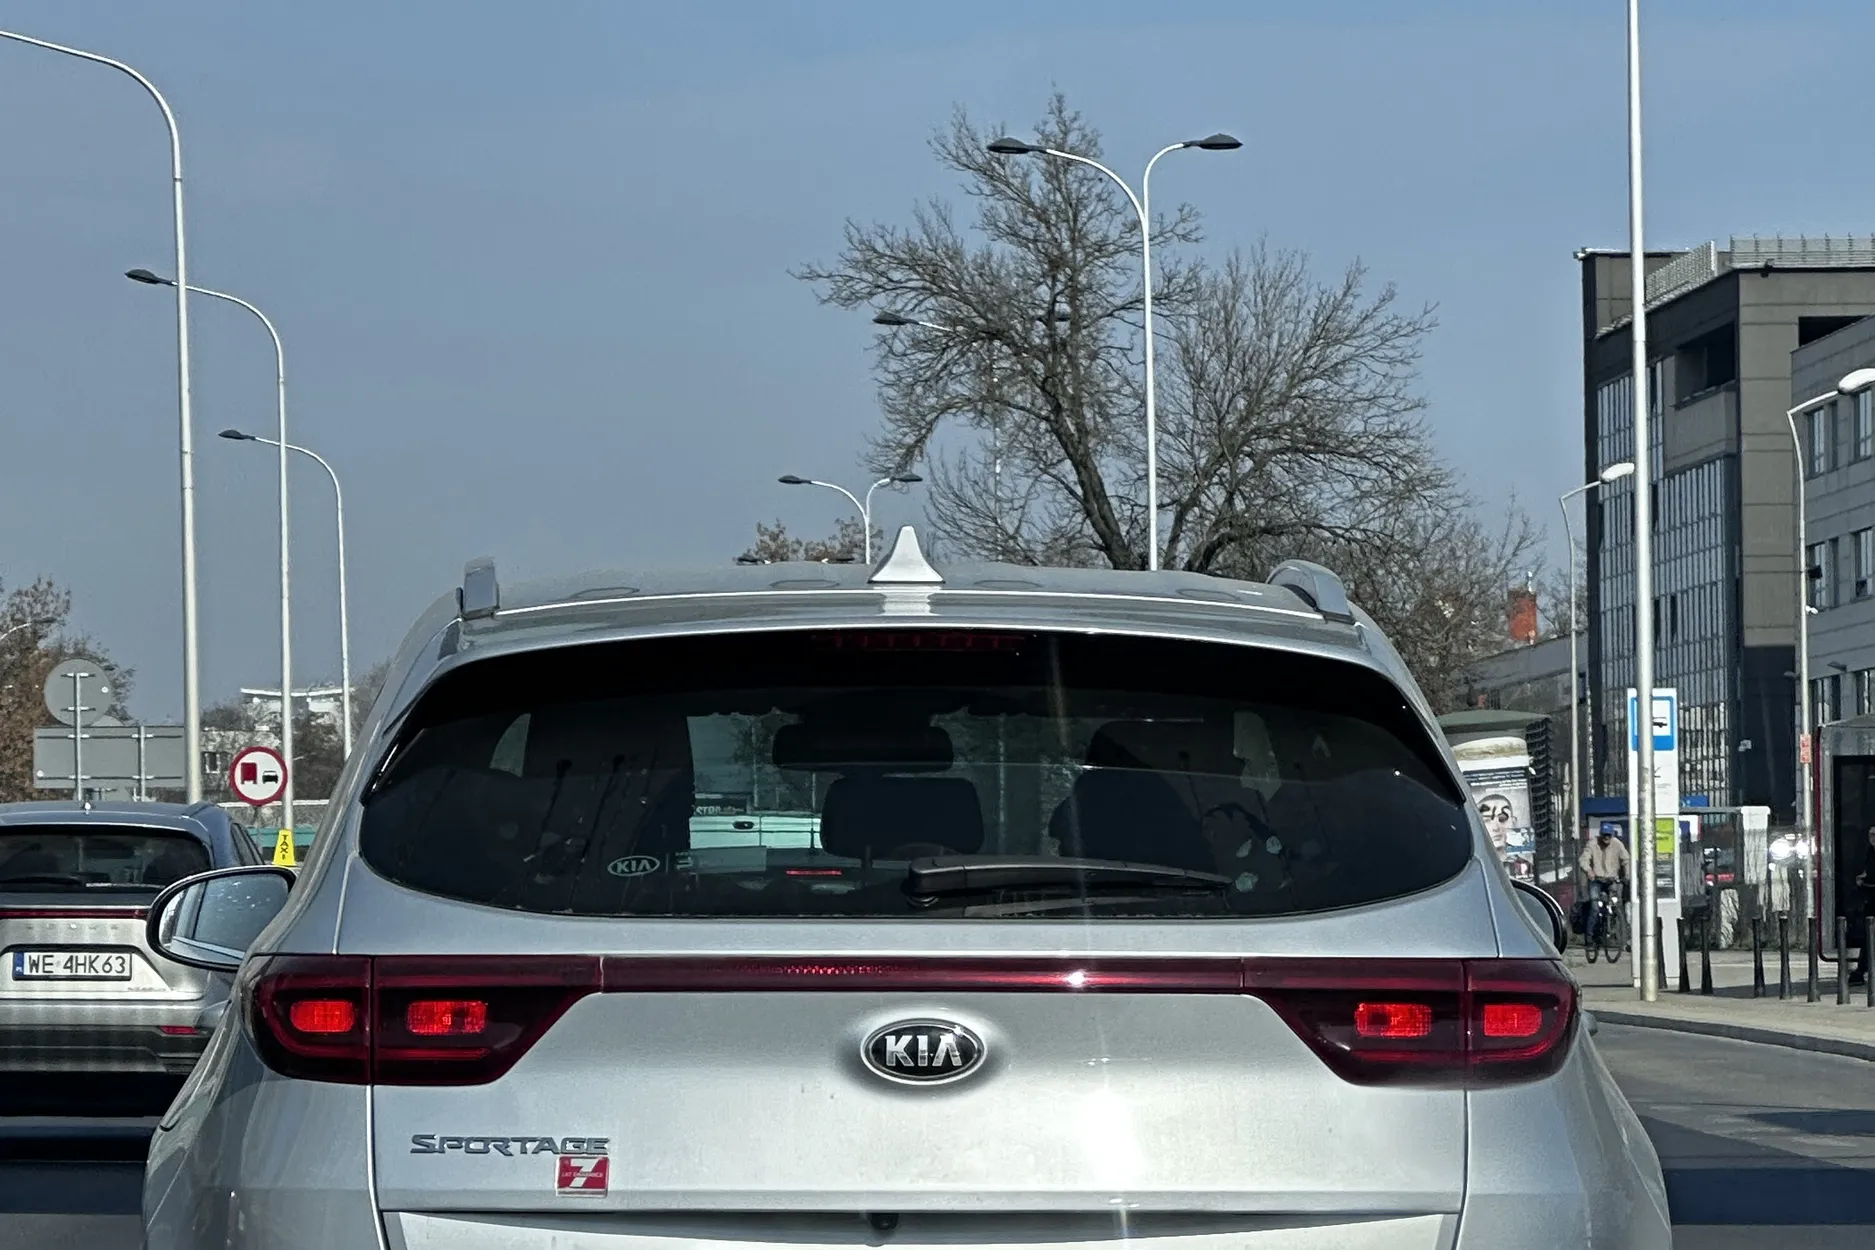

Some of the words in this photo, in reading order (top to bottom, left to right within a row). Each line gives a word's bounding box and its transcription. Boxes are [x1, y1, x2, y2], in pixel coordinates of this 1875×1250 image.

[280, 834, 289, 860] TAXI
[28, 955, 54, 974] WE
[63, 955, 126, 974] 4HK63
[885, 1034, 963, 1067] KIA
[410, 1134, 610, 1157] SPORTAGE
[569, 1158, 600, 1188] 7
